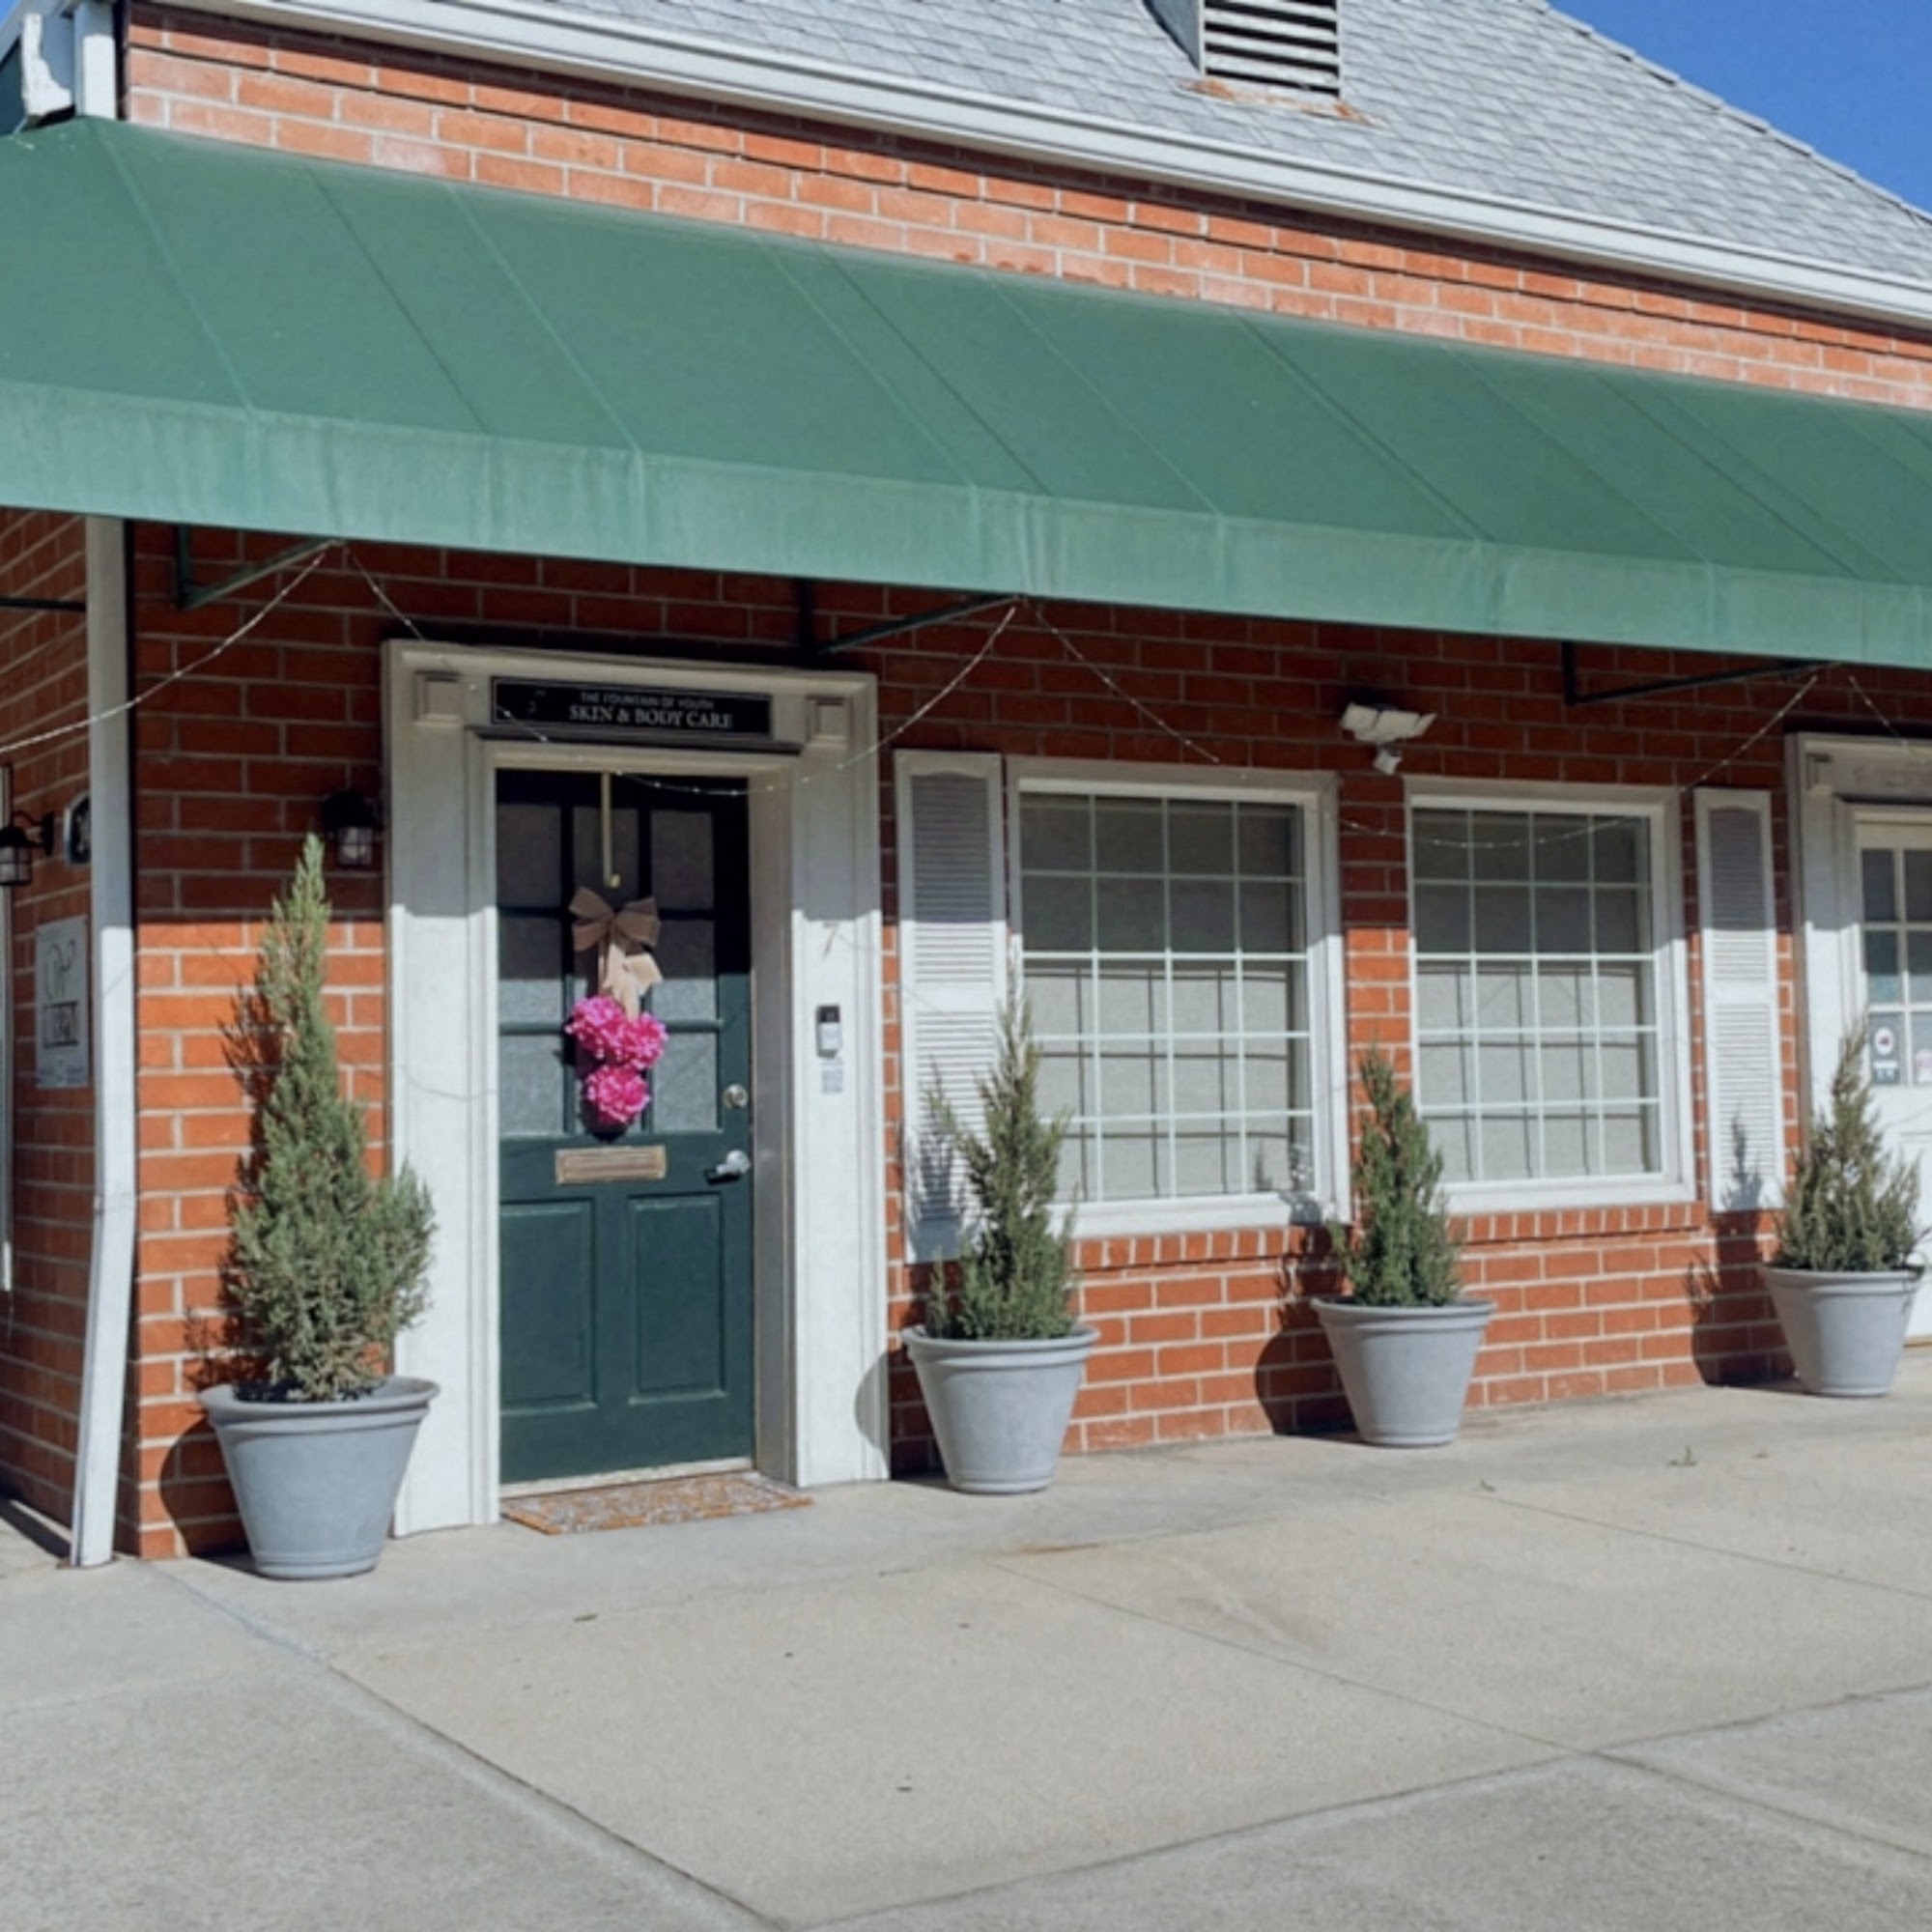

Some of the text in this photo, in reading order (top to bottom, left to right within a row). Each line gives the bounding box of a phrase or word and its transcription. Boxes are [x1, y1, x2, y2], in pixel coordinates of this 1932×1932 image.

[581, 691, 600, 703] THE
[603, 692, 659, 706] FOUNTAIN
[662, 695, 675, 707] OF
[569, 704, 733, 728] SKIN & BODY CARE
